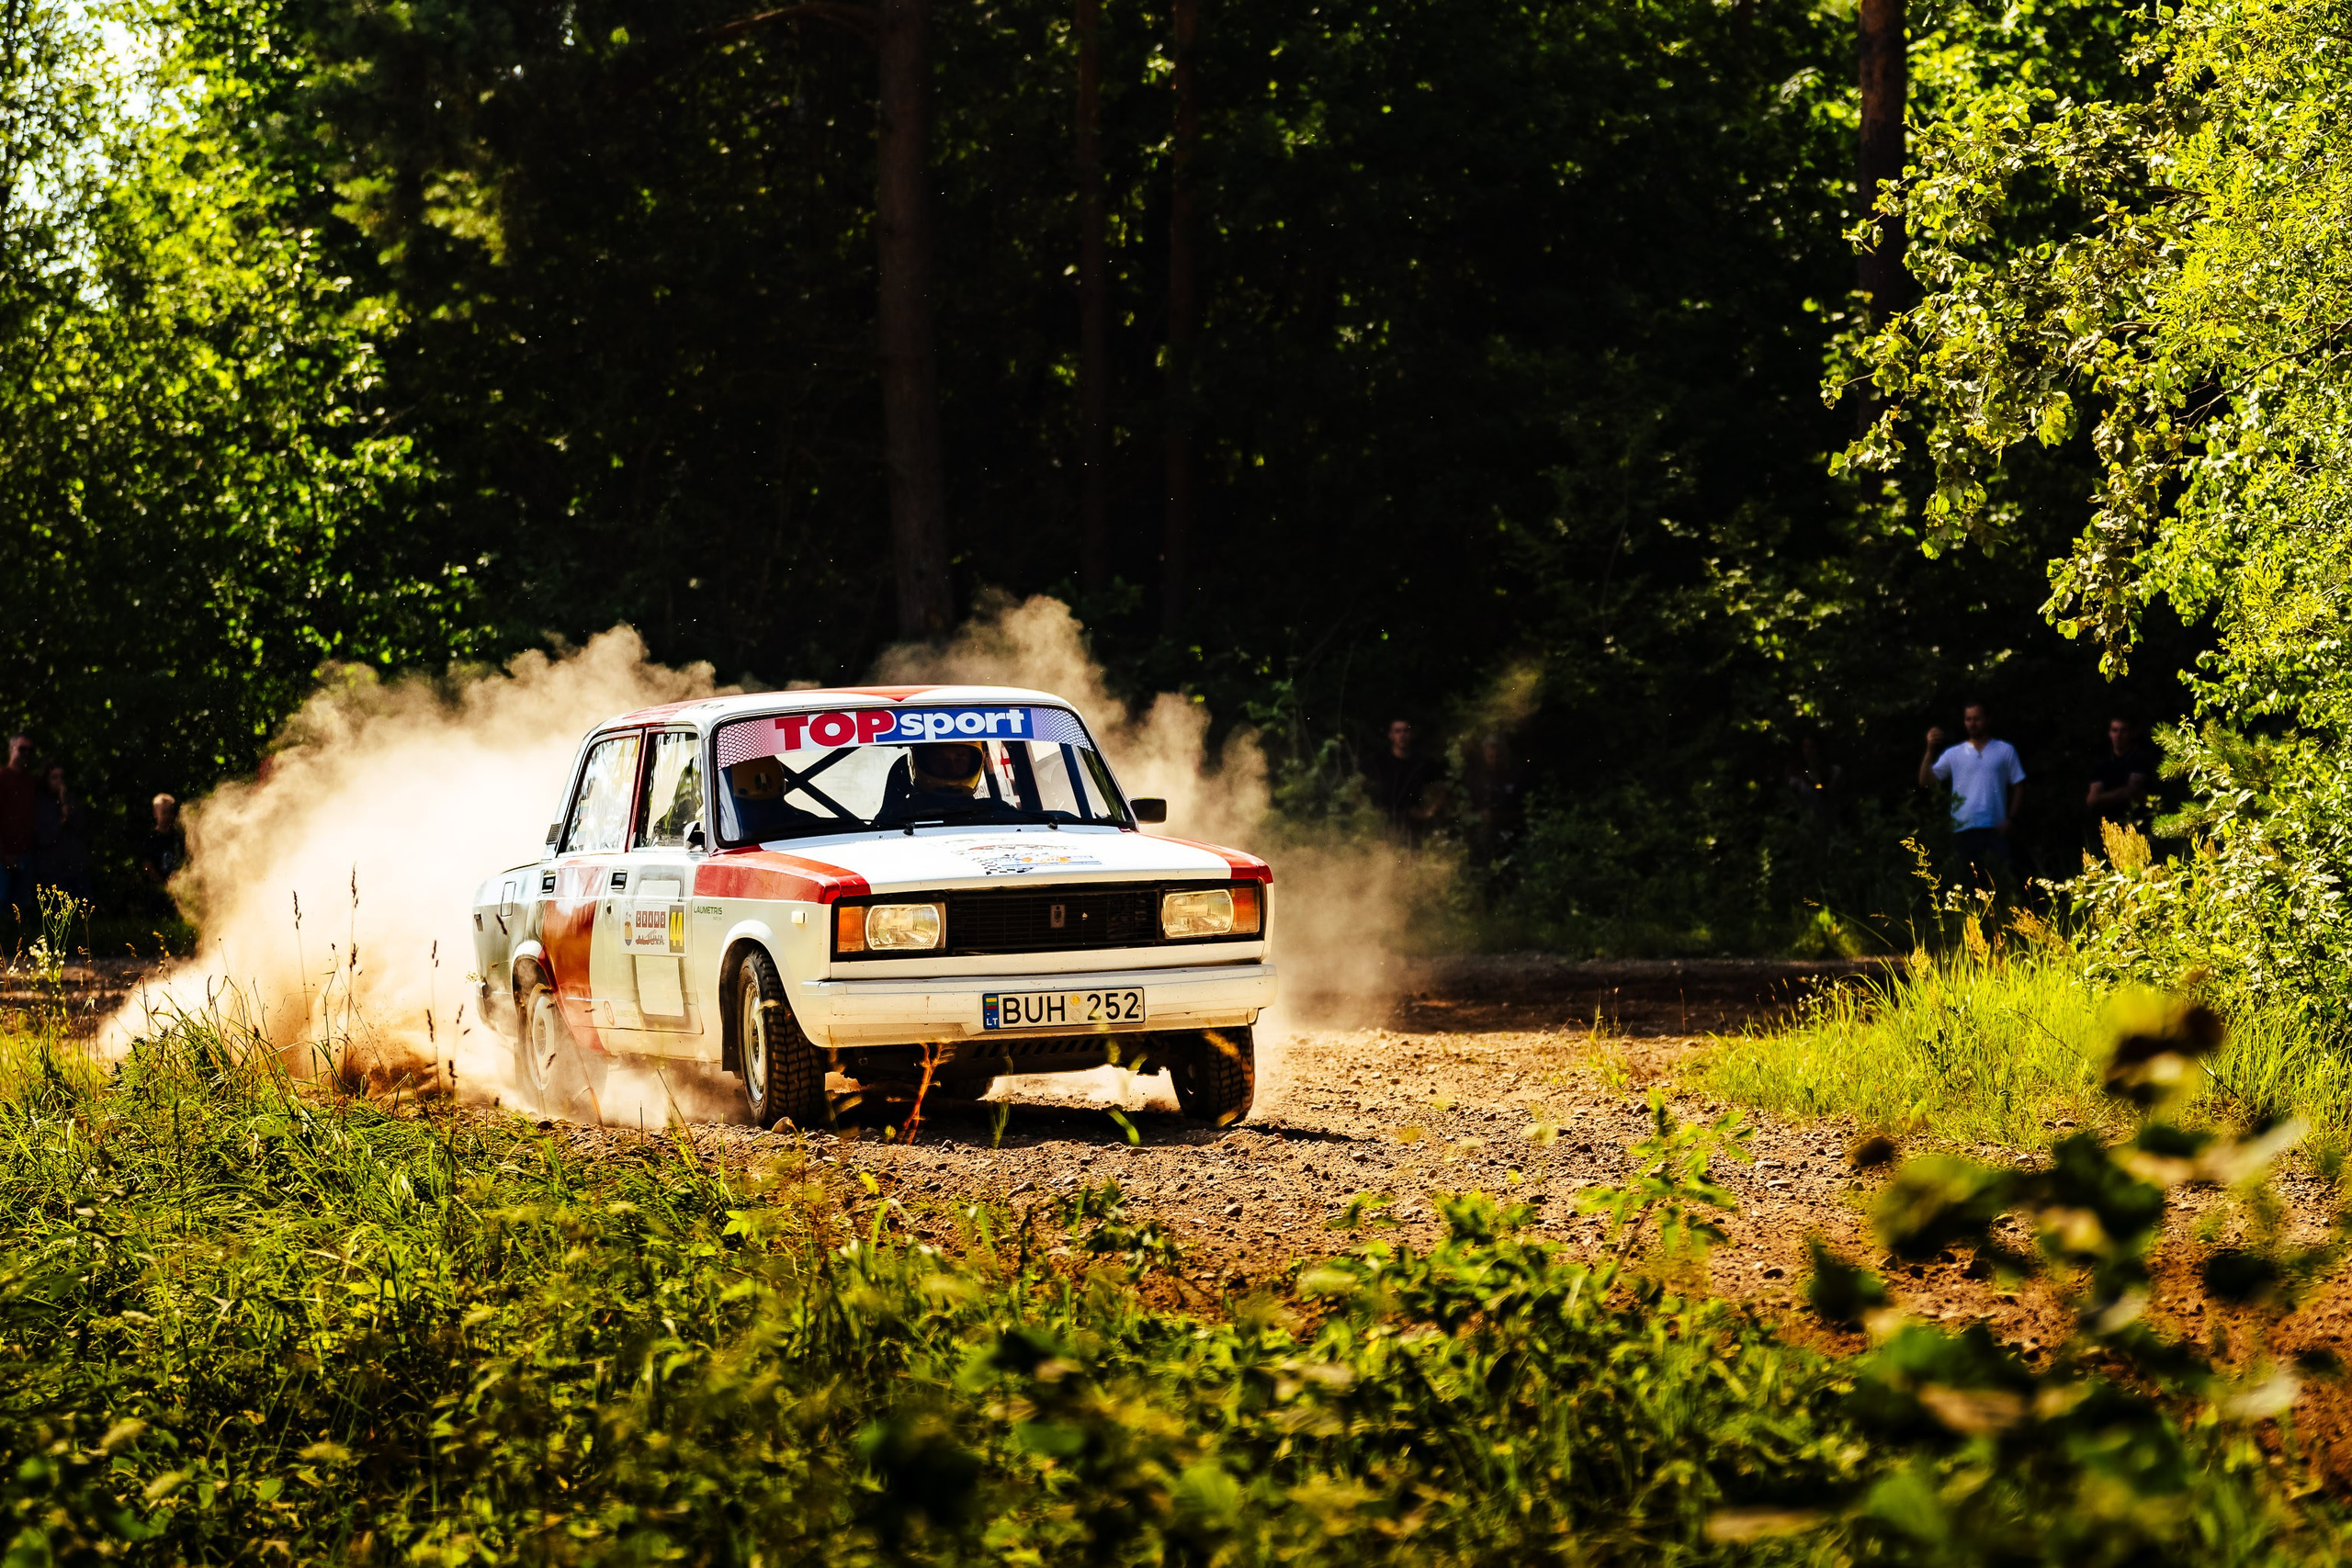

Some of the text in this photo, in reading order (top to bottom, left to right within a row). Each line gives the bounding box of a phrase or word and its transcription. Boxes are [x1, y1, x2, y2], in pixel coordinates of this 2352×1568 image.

[694, 906, 723, 915] LAUMETRIS
[669, 911, 684, 947] 44
[1002, 992, 1139, 1024] BUH 252
[986, 1017, 999, 1026] LT
